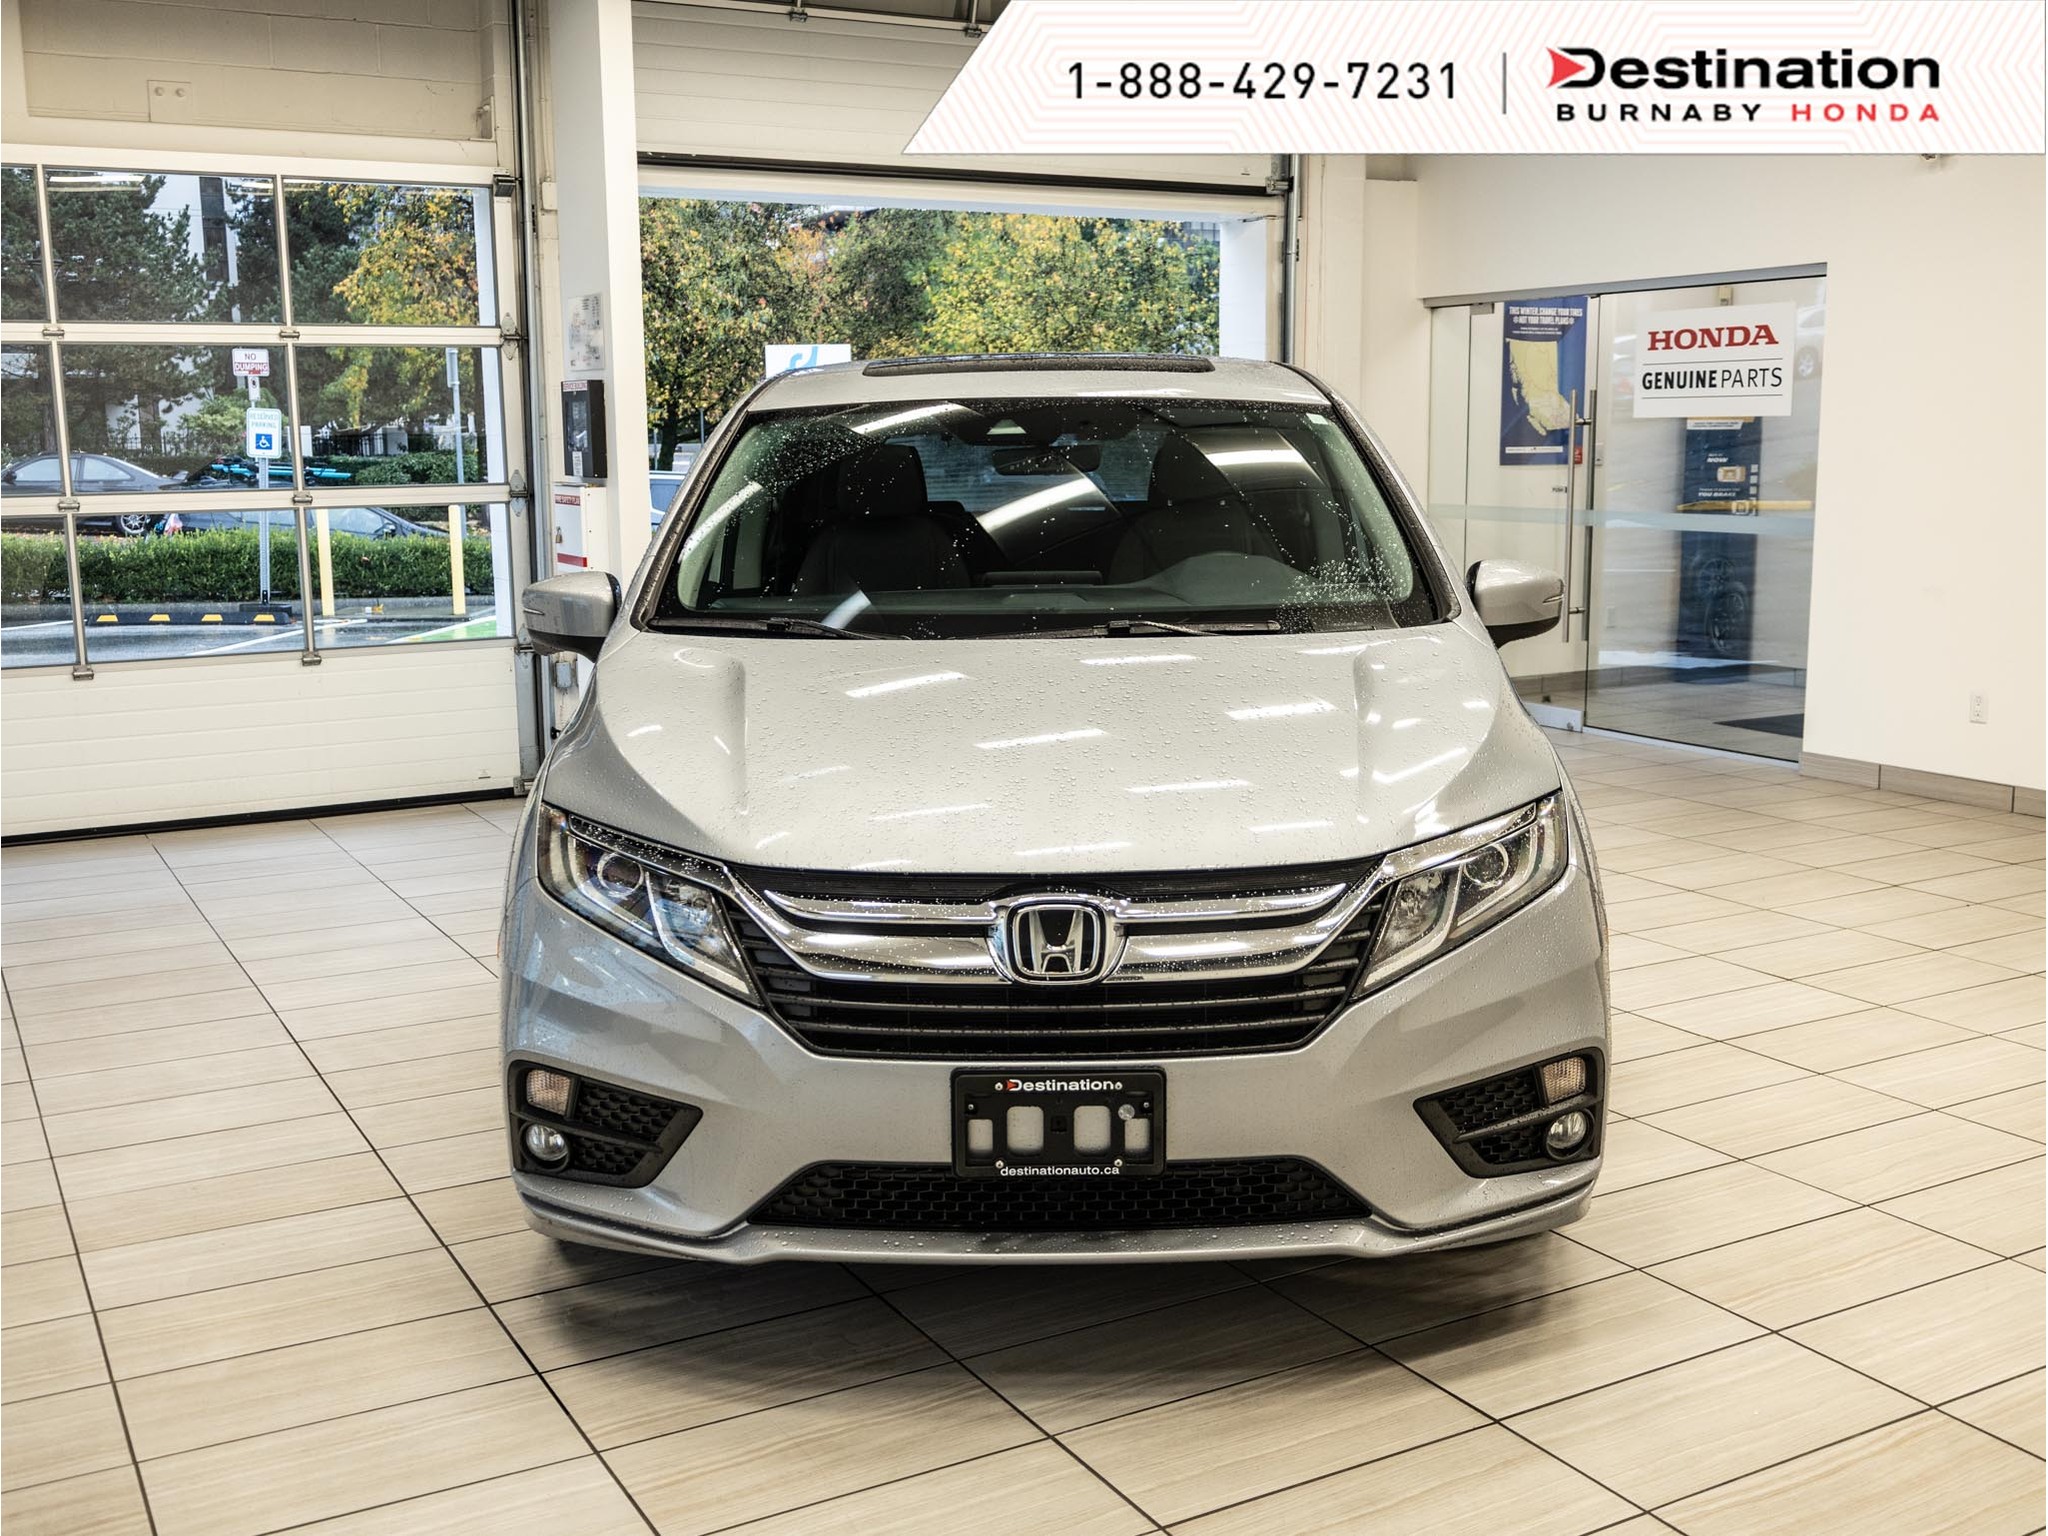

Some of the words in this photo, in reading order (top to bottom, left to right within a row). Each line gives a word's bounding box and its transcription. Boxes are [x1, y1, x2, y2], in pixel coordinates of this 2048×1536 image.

[1647, 324, 1780, 351] HONDA
[234, 362, 269, 371] DUMPING
[1641, 369, 1718, 390] GENUINE
[1720, 367, 1783, 388] PARTS
[1007, 1079, 1115, 1092] Destination
[1000, 1166, 1120, 1177] destinationauto.ca
